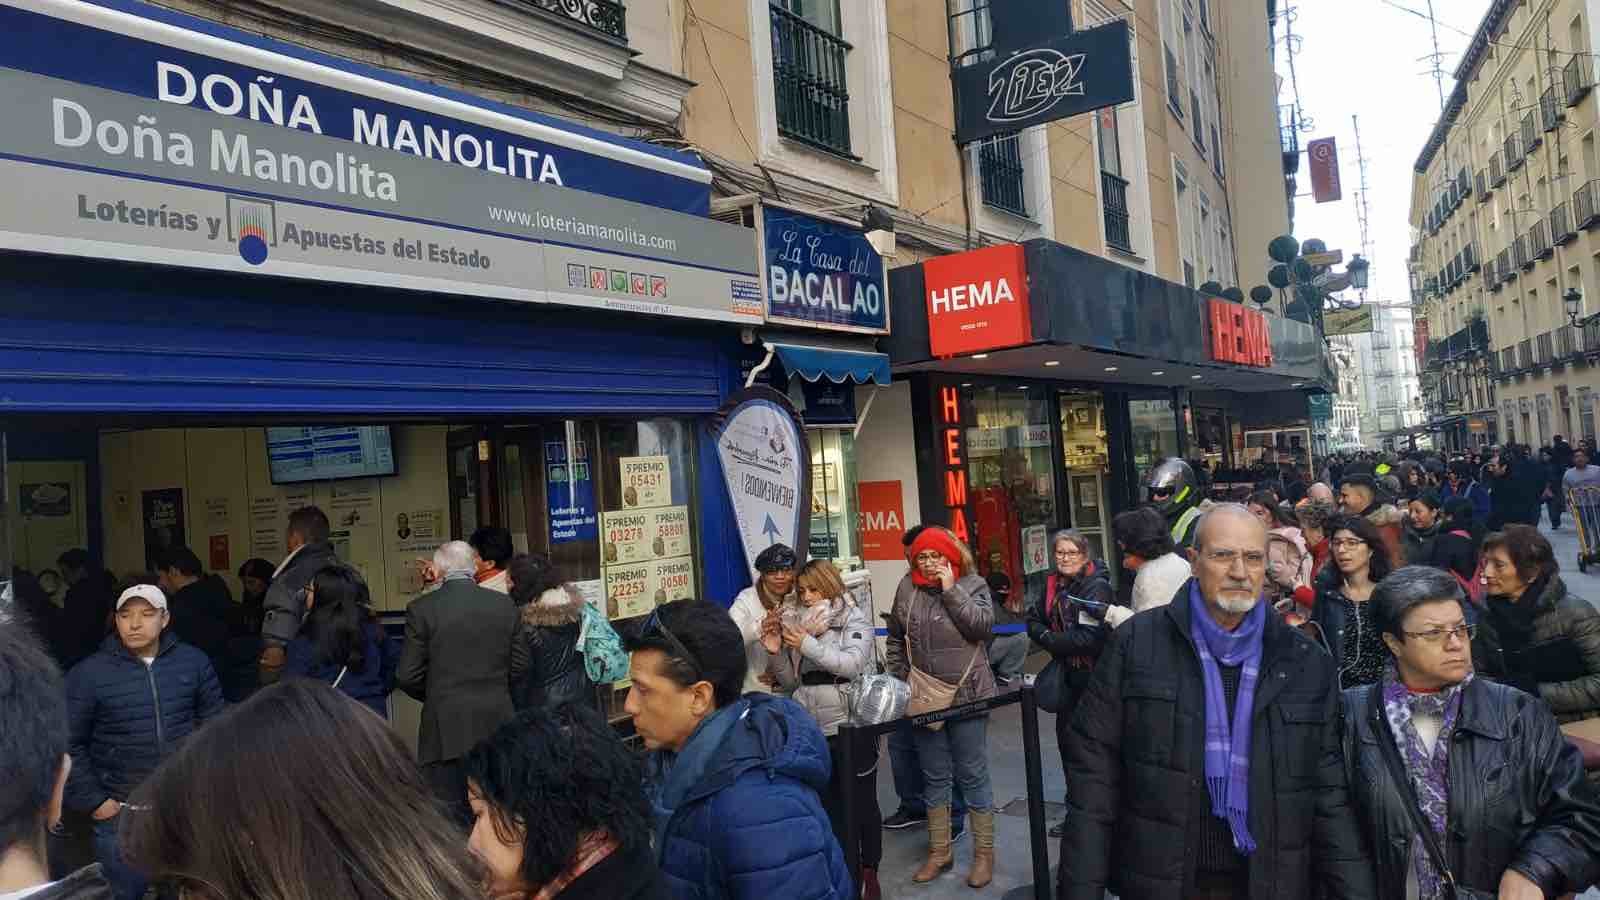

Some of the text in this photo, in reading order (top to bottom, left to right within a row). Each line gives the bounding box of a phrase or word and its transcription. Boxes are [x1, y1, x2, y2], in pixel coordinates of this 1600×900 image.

[52, 97, 398, 202] Doña Manolita
[157, 61, 563, 186] DOÑA MANOLITA
[77, 194, 491, 270] Loterías y Apuestas del Estado
[488, 205, 677, 251] www.loteriamanolita.com
[779, 230, 872, 277] La Casa del
[770, 265, 880, 316] BACALAO
[931, 277, 1014, 314] HEMA
[1210, 299, 1273, 367] HEMA
[942, 386, 969, 544] HEMA
